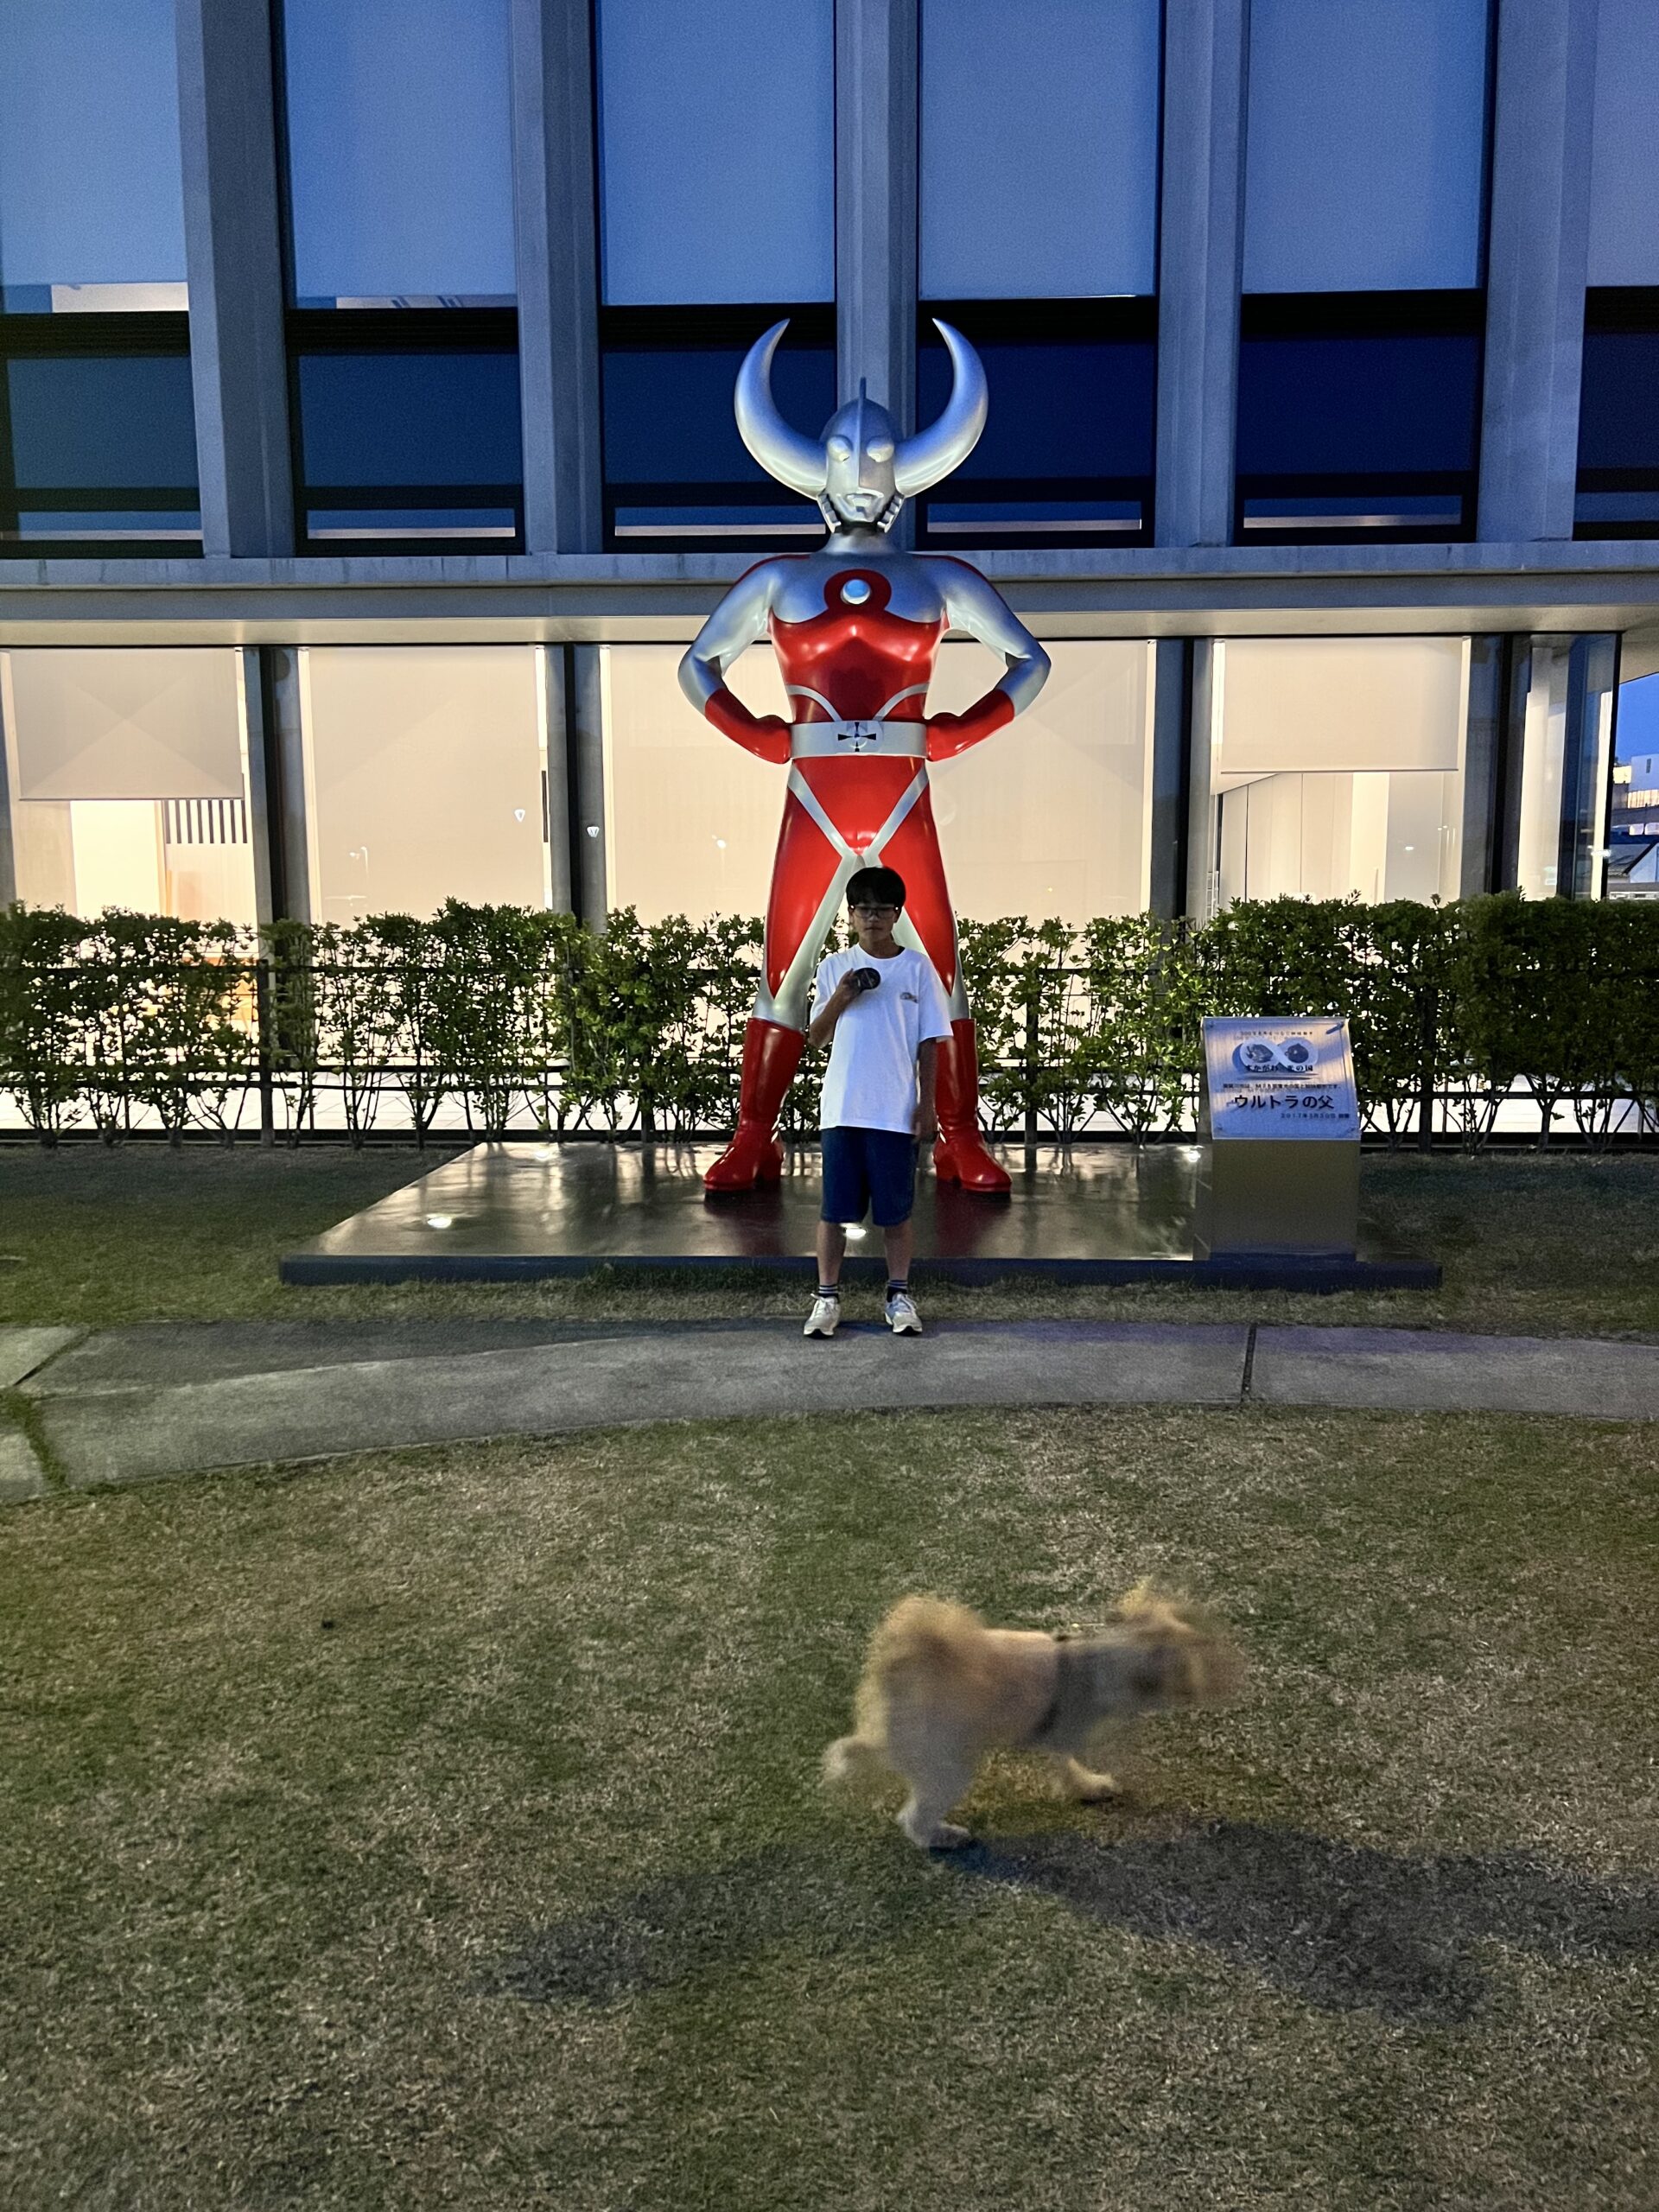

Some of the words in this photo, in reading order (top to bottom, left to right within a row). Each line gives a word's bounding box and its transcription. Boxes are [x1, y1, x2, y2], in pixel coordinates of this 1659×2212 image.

[1234, 1094, 1335, 1109] ウルトラの父
